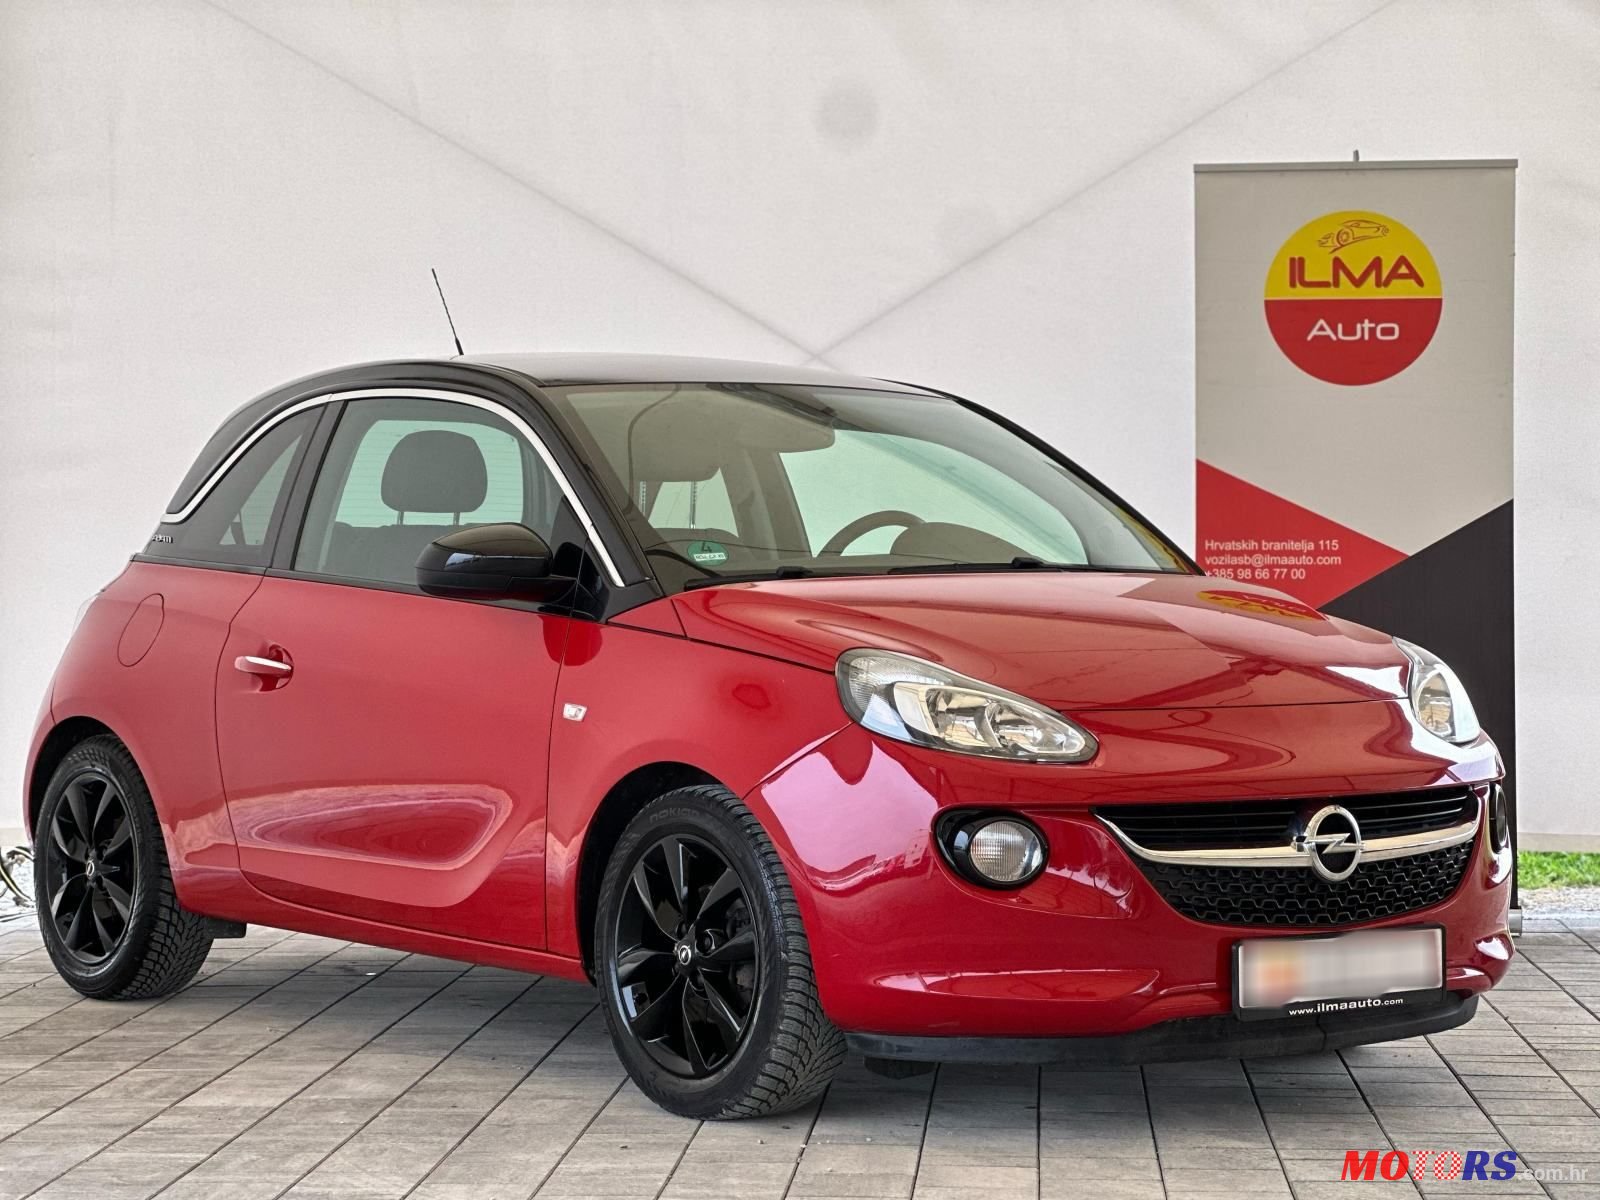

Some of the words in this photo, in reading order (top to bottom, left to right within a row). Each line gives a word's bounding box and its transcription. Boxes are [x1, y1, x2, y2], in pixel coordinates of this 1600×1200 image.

[1289, 254, 1424, 289] ILMA
[1307, 318, 1400, 341] Auto
[1205, 539, 1258, 551] Hrvatskih
[1262, 539, 1314, 553] branitelja
[1319, 539, 1339, 551] 115
[1205, 554, 1341, 567] vozilasb@ilmaauto.com
[1237, 569, 1251, 580] 98
[1255, 569, 1269, 580] 66
[1273, 569, 1287, 580] 77
[1291, 569, 1306, 580] 00
[1288, 997, 1404, 1016] www.ilmaauto.com
